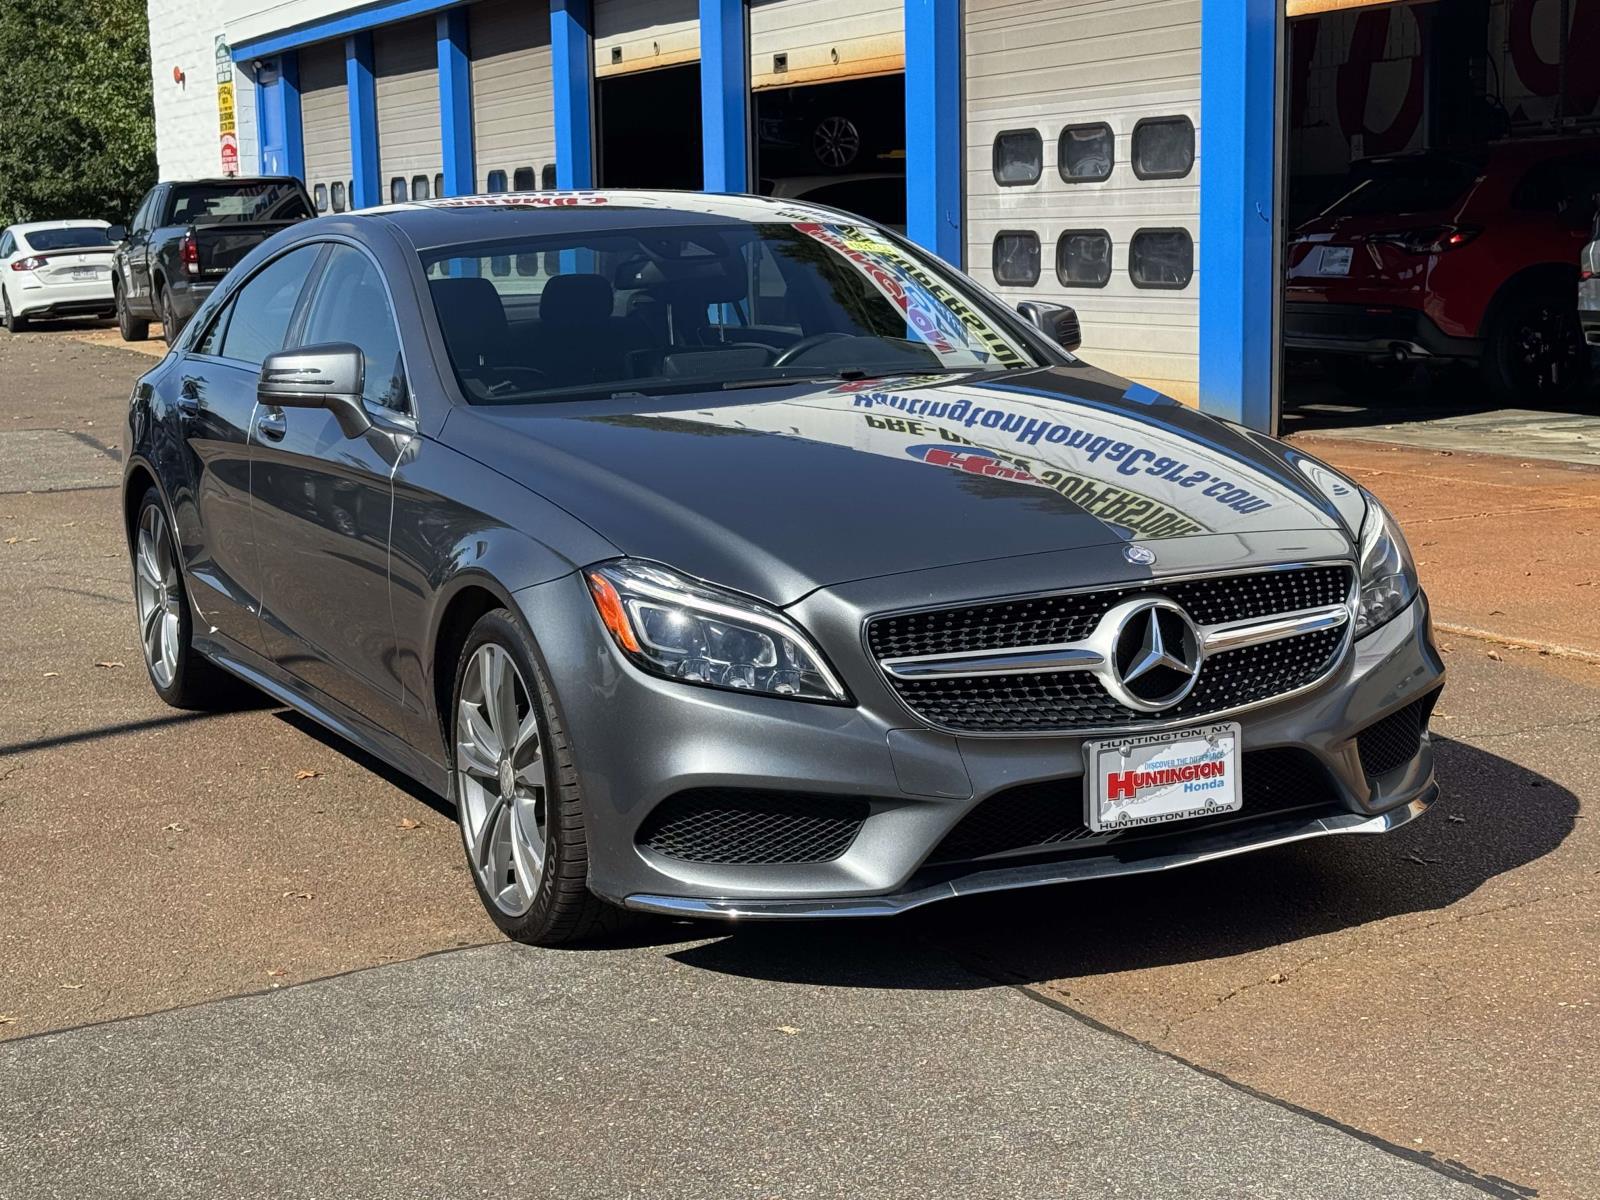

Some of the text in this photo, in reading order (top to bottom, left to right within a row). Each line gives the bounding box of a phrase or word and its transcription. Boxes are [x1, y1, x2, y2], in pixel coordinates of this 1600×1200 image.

[1100, 724, 1232, 749] HUNTINGTON, NY
[1144, 758, 1177, 770] DISCOVER
[1177, 757, 1189, 766] THE
[1107, 760, 1225, 801] HUNTINGTON
[1183, 779, 1225, 793] Honda
[1100, 804, 1234, 830] HUNTINGTON HONDA
